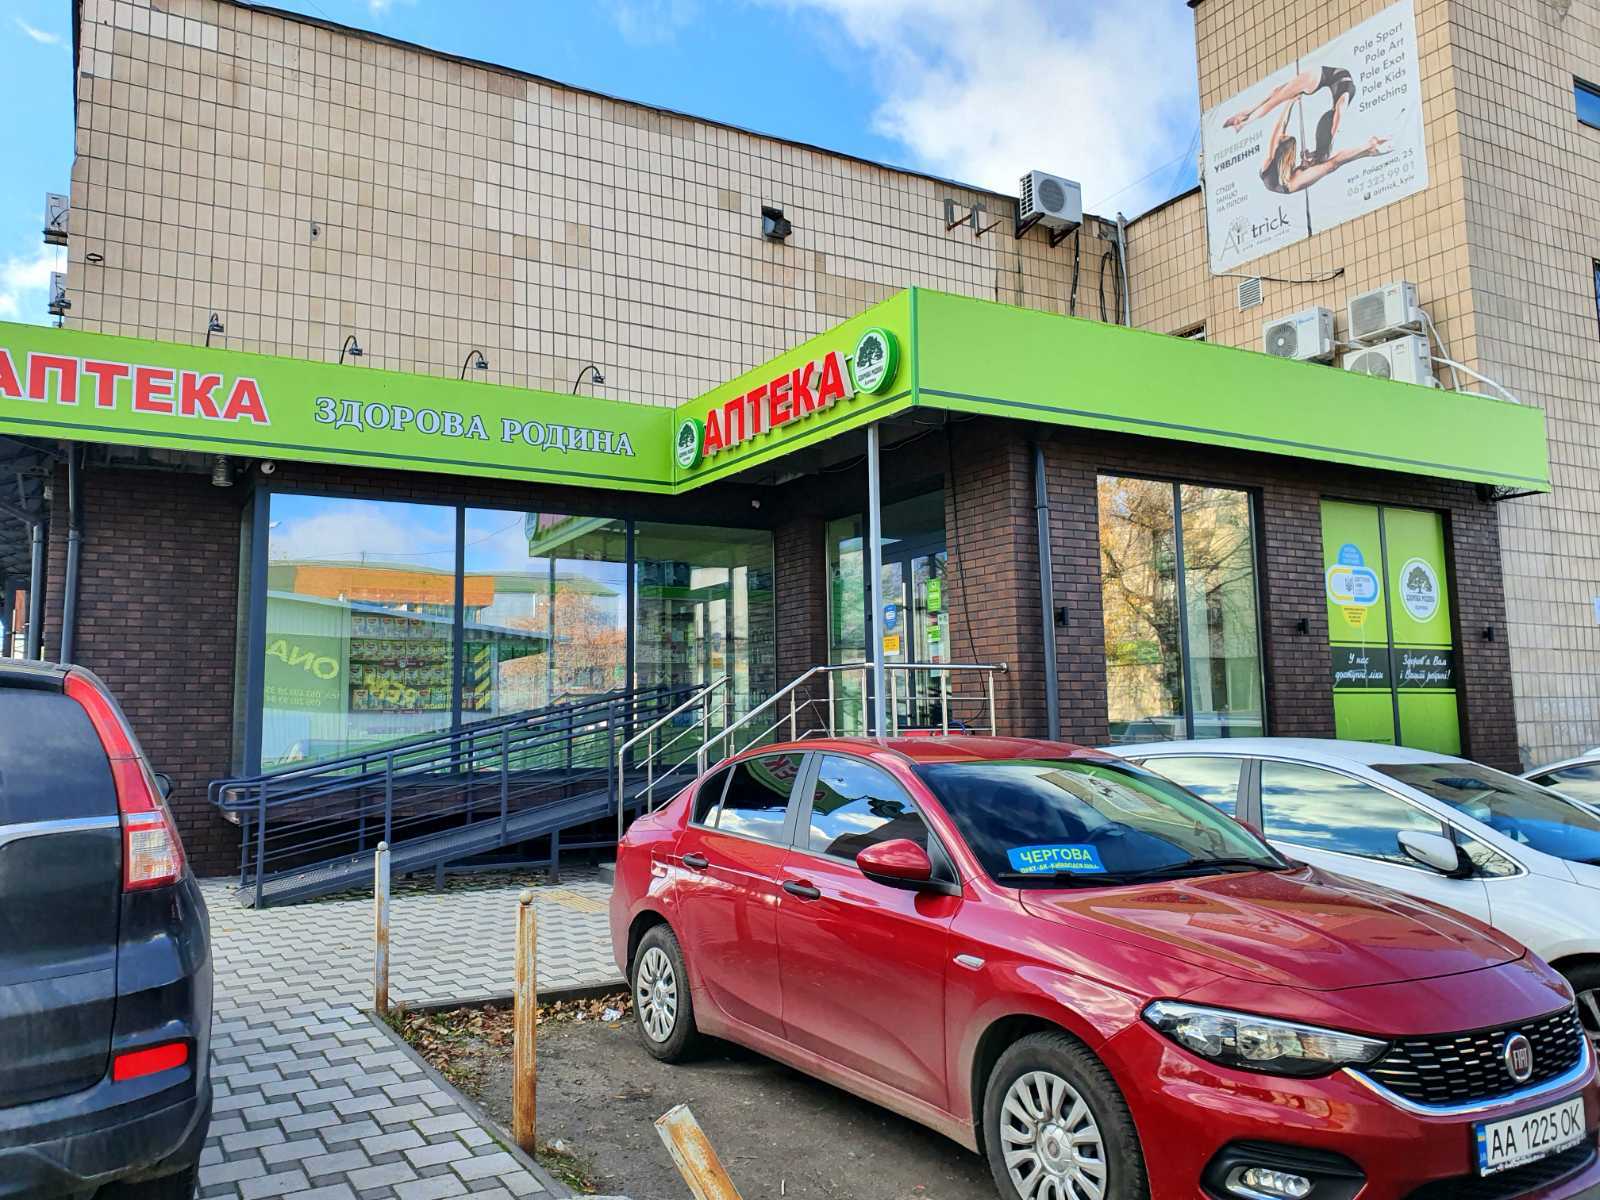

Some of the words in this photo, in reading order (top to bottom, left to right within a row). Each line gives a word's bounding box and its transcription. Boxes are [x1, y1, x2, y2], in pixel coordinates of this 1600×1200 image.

[1353, 40, 1374, 55] Pole
[1376, 21, 1403, 43] Sport
[1365, 49, 1386, 64] Pole
[1389, 38, 1405, 51] Art
[1360, 66, 1381, 81] Pole
[1383, 52, 1405, 70] Exot
[1362, 81, 1383, 96] Pole
[1385, 67, 1407, 84] Kids
[1359, 84, 1408, 113] Stretching
[1213, 144, 1261, 173] УЯВЛЕННЯ
[1251, 204, 1290, 239] trick
[703, 351, 854, 457] АПТЕКА
[314, 396, 489, 440] ЗДОРОВА
[500, 417, 636, 457] РОДИНА
[1019, 848, 1093, 864] ЧЕРГОВА
[1513, 1047, 1529, 1070] FIAT
[1491, 1125, 1518, 1161] AA
[1521, 1112, 1558, 1151] 1225
[1561, 1103, 1582, 1137] OK
